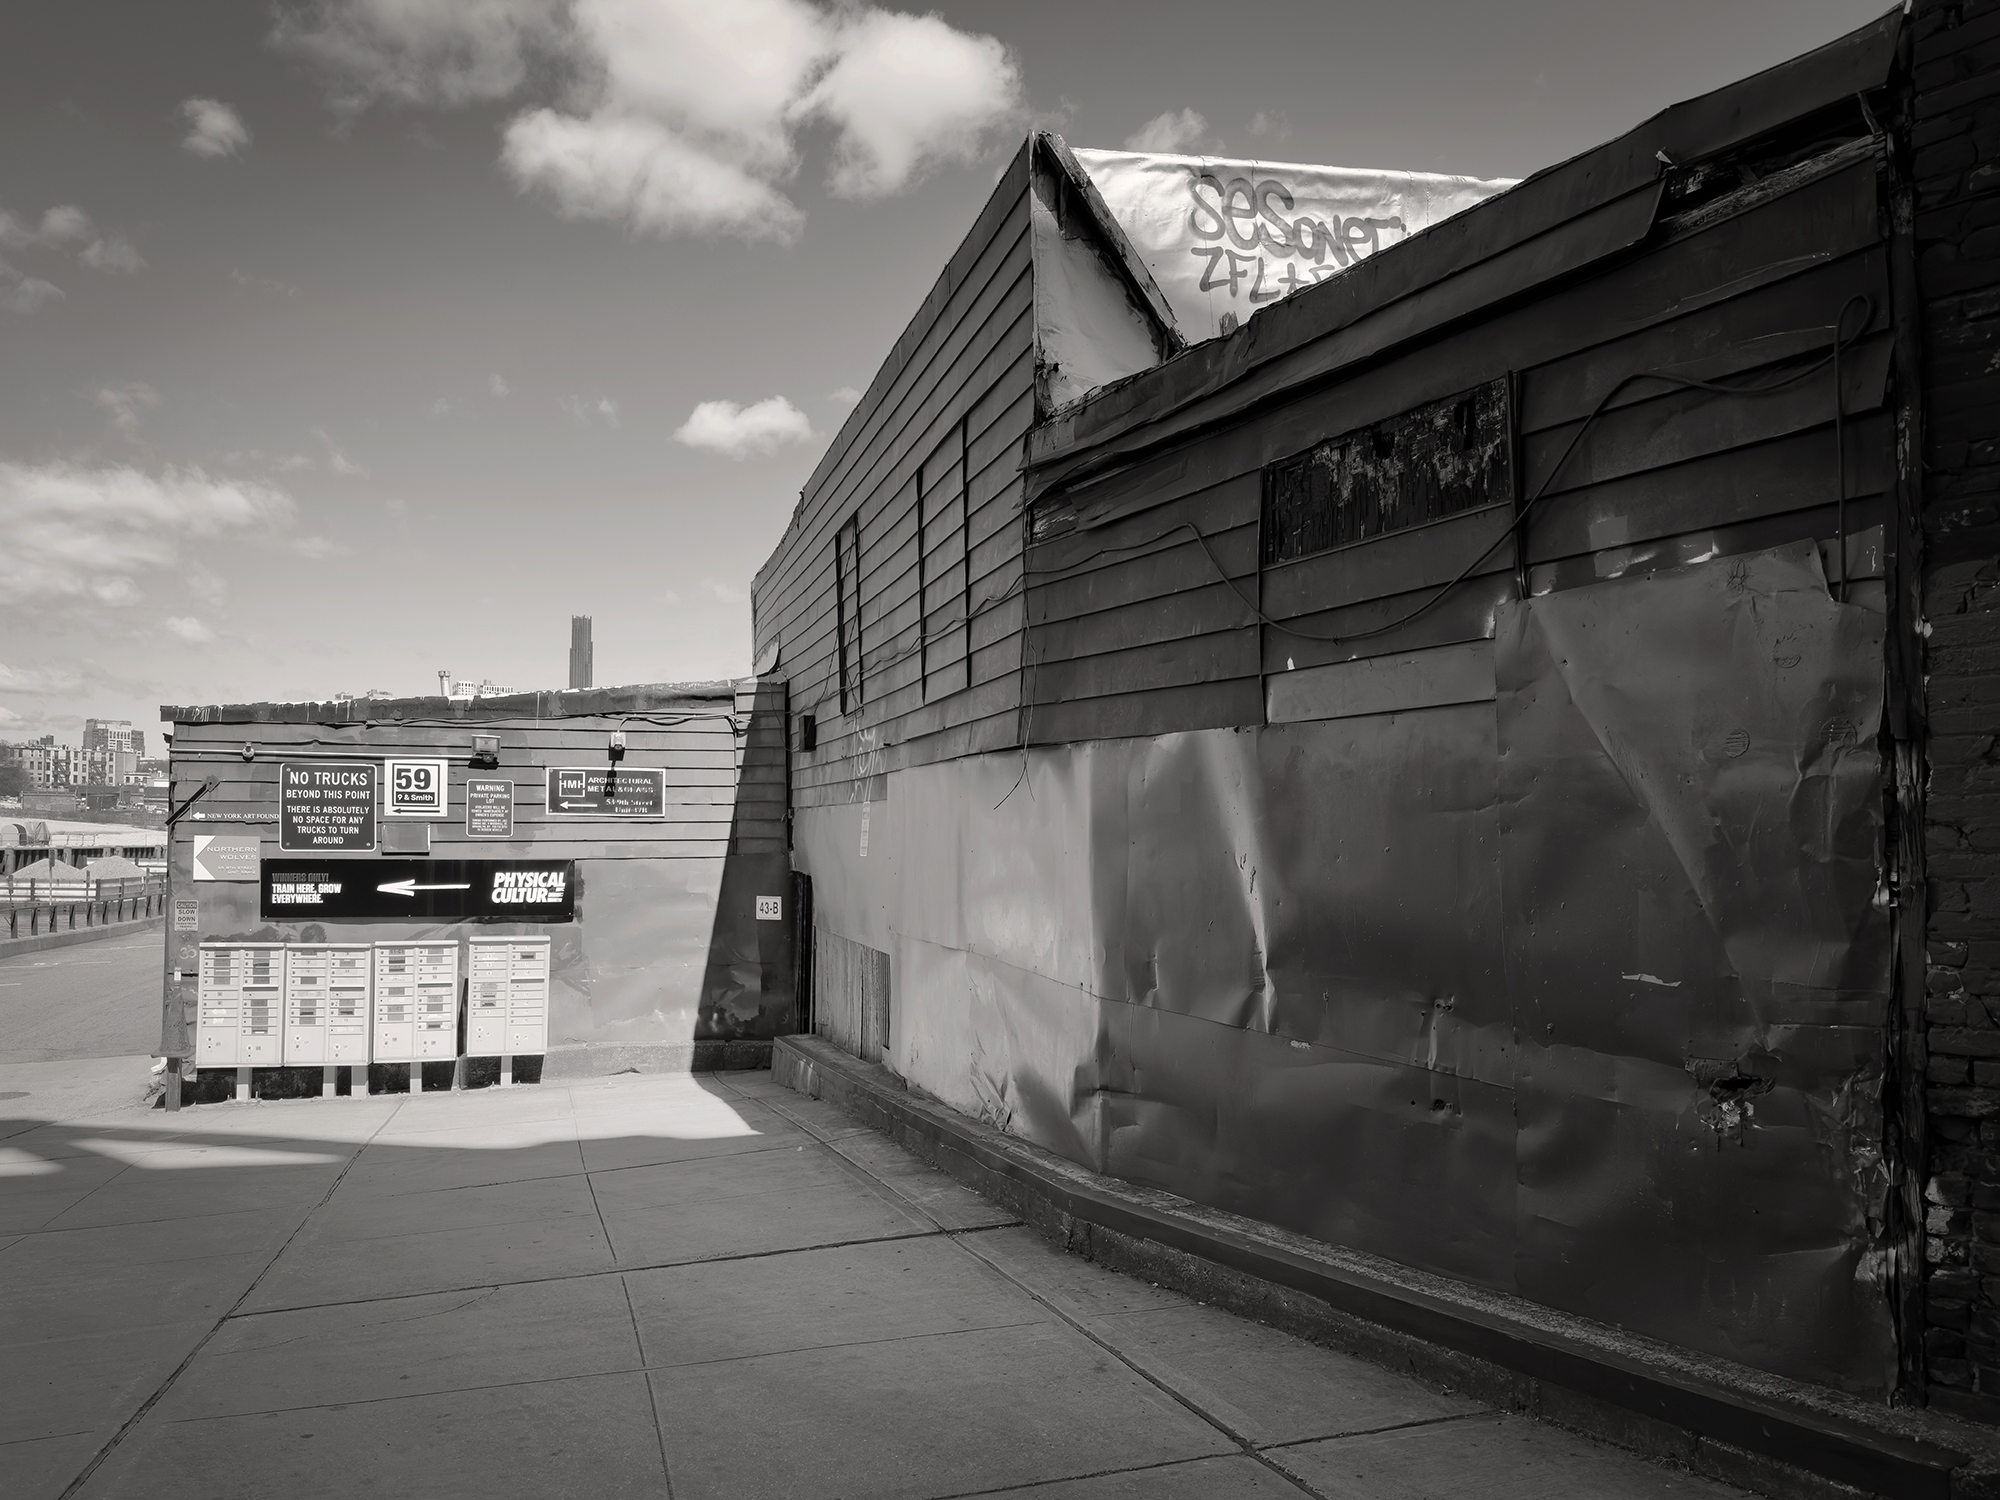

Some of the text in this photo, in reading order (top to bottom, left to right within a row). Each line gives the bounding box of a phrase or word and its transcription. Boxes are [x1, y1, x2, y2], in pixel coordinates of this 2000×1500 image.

[290, 772, 368, 786] NO TRUCKS
[395, 768, 432, 791] 59
[588, 777, 654, 785] ARCHITECTURAL
[286, 790, 371, 800] BEYOND THIS POINT
[323, 806, 370, 814] ABSOLUTELY
[292, 816, 364, 824] NO SPACE FOR ANY
[297, 826, 359, 834] TRUCKS TO TURN
[312, 836, 344, 845] AROUND
[271, 872, 329, 883] WINNERS ONLY!
[493, 872, 566, 888] PHYSICAL
[271, 883, 342, 895] TRAIN HERE, GROW
[271, 893, 324, 904] EVERYWHERE.
[759, 901, 779, 915] 43-B
